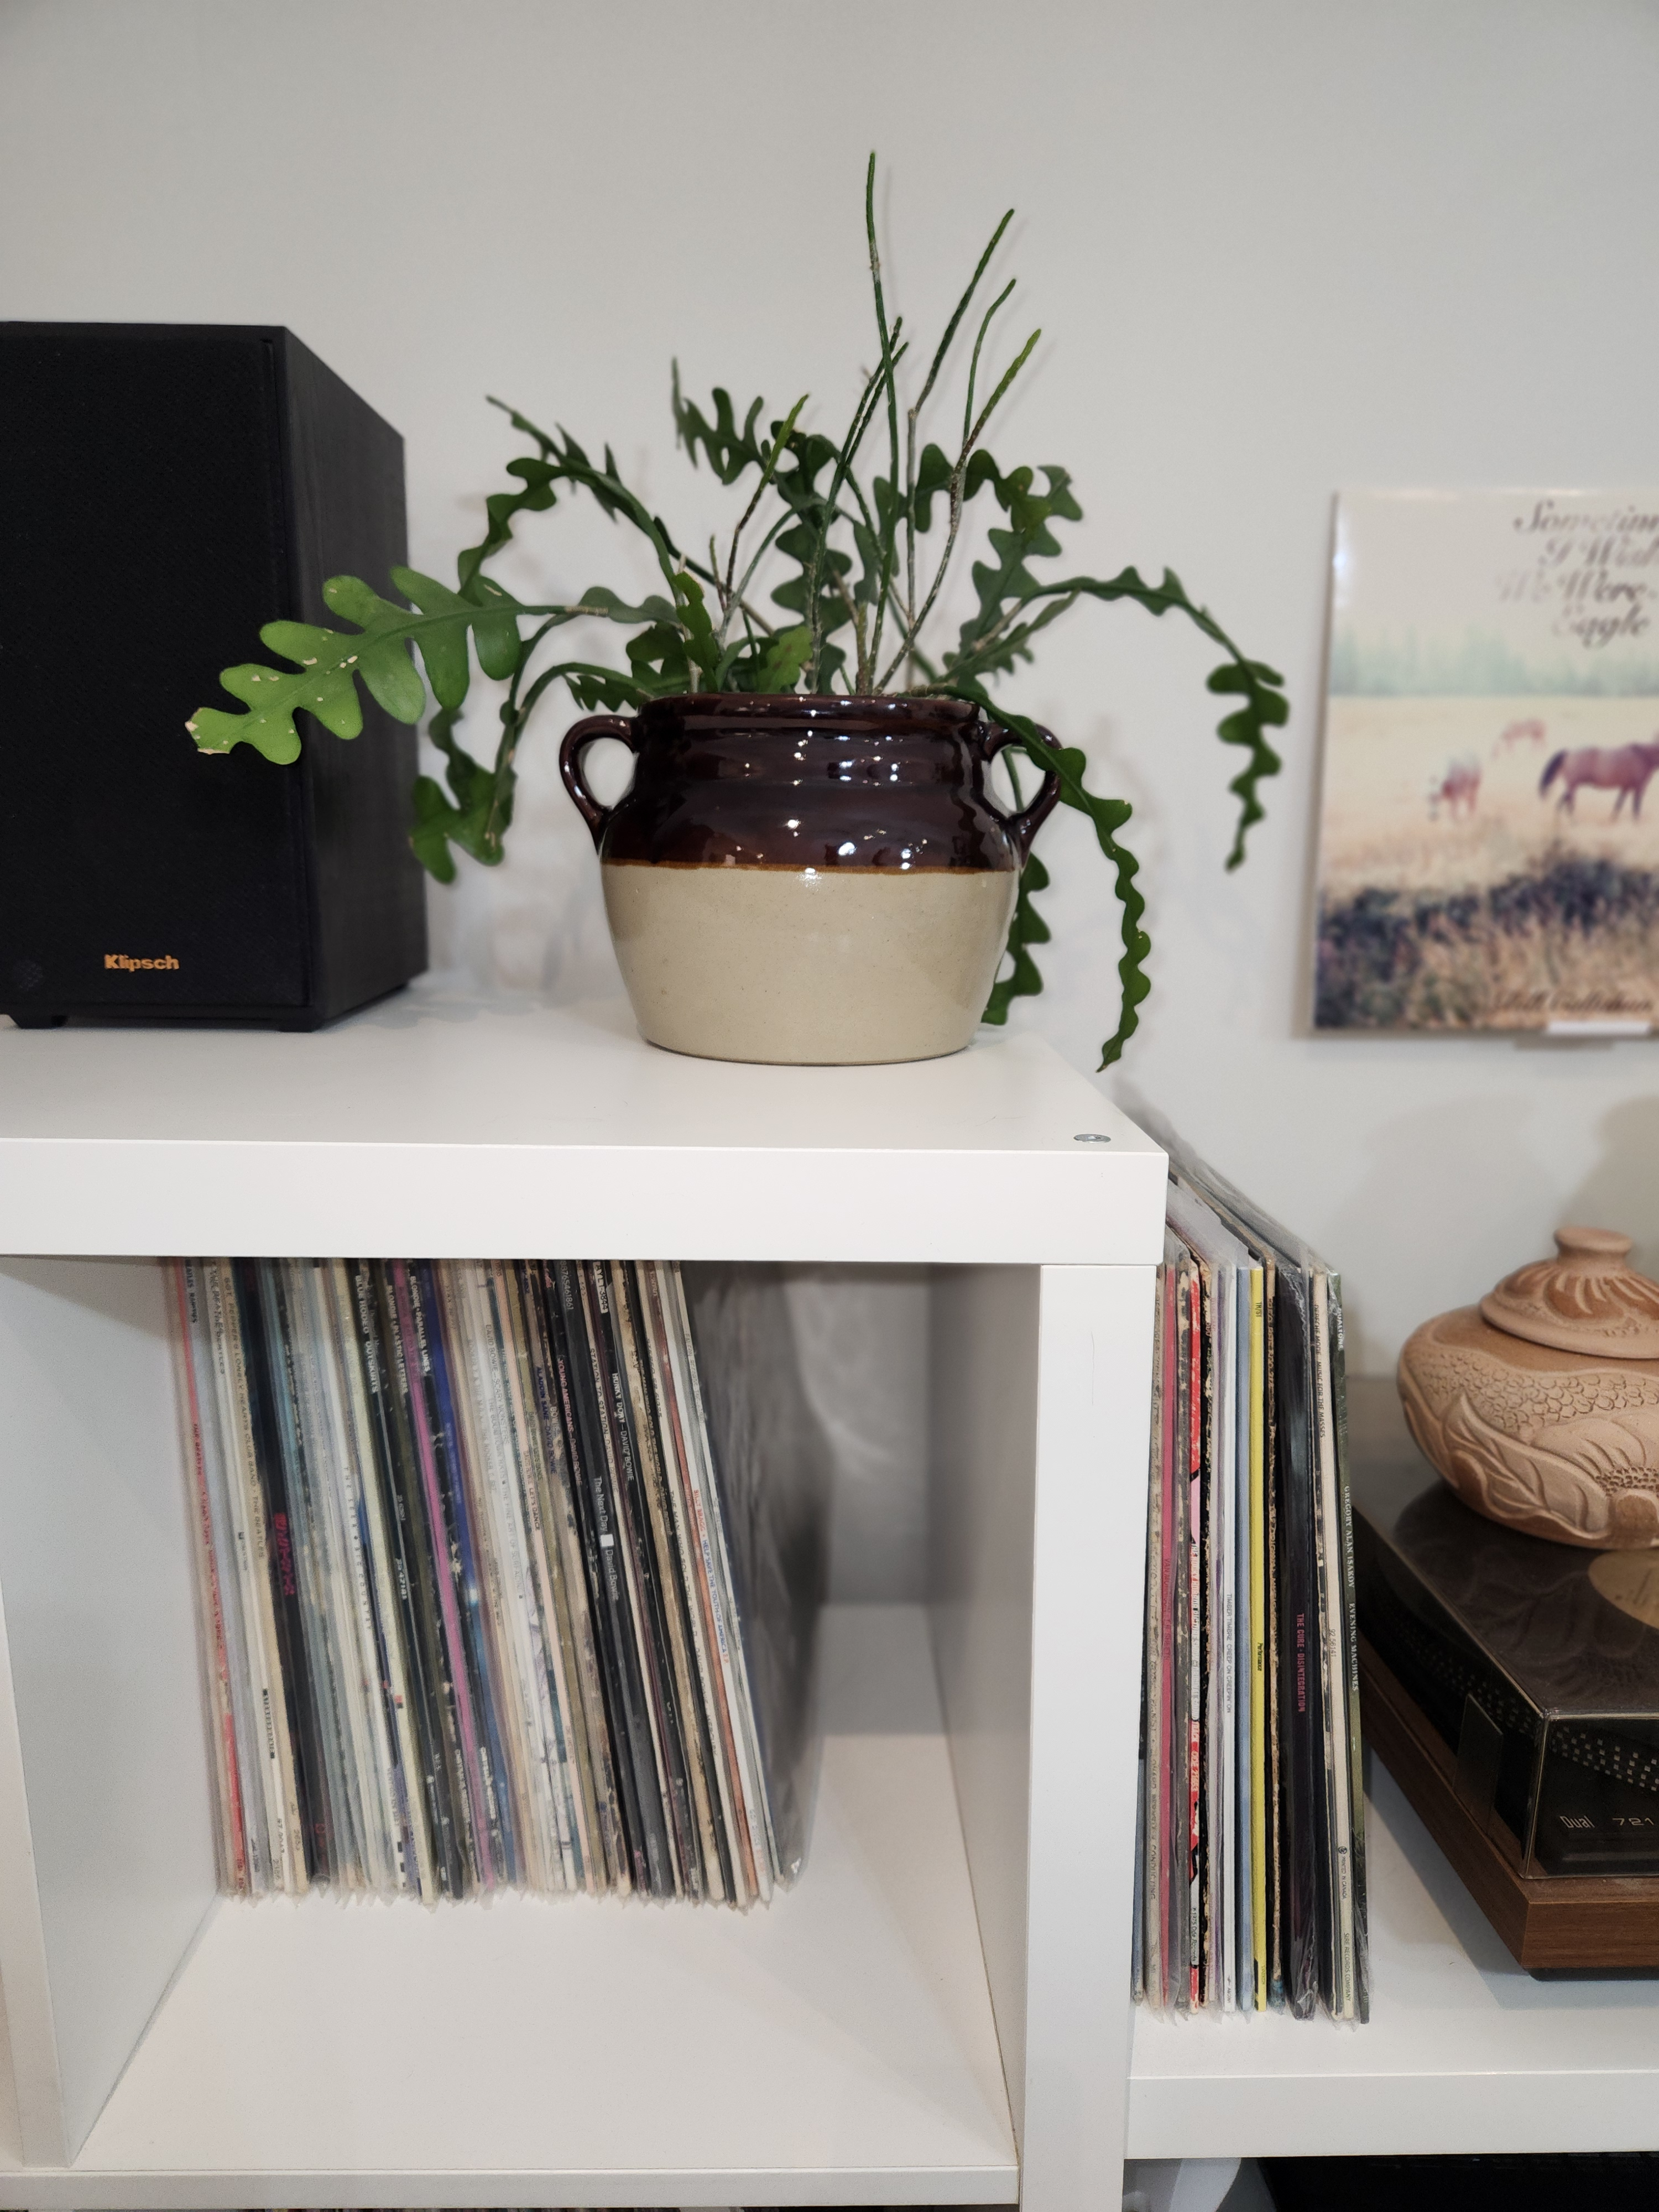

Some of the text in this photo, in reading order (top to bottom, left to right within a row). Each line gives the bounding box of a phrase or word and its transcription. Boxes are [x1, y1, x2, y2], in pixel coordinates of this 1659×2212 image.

[104, 953, 180, 973] Klipsch
[385, 1285, 398, 1319] BLONDIE
[409, 1276, 422, 1307] BLONDIE
[354, 1275, 379, 1394] BLUE RODEO OUTSKIRTS
[390, 1324, 404, 1358] PLASTIC
[414, 1311, 428, 1349] PARALLEL
[395, 1359, 409, 1394] LETTERS
[420, 1349, 431, 1372] LINES
[556, 1359, 568, 1387] YOUNG
[484, 1324, 510, 1445] DAVID BOWIE SCARY MONSTERS
[535, 1366, 557, 1474] ALADDIN SANE DAVID BOWIE
[561, 1388, 574, 1432] AMERICANS
[611, 1373, 635, 1481] HUNKY DORY DAVID BOWIE
[593, 1475, 610, 1531] The Next Day
[692, 1489, 702, 1507] BILLY
[531, 1507, 541, 1531] DANCE
[696, 1509, 706, 1531] BRAGG
[1343, 1485, 1355, 1588] GREGORY ALAN ISAKOV
[604, 1549, 621, 1601] David Bowie
[1328, 1629, 1335, 1637] 92
[1348, 1603, 1359, 1691] EVENING MACHINES
[1226, 1665, 1233, 1674] ON
[1296, 1613, 1307, 1713] THE CURE DISINTEGRATION
[1559, 1815, 1655, 1829] Dual 721
[1343, 1947, 1351, 1973] RECORDS
